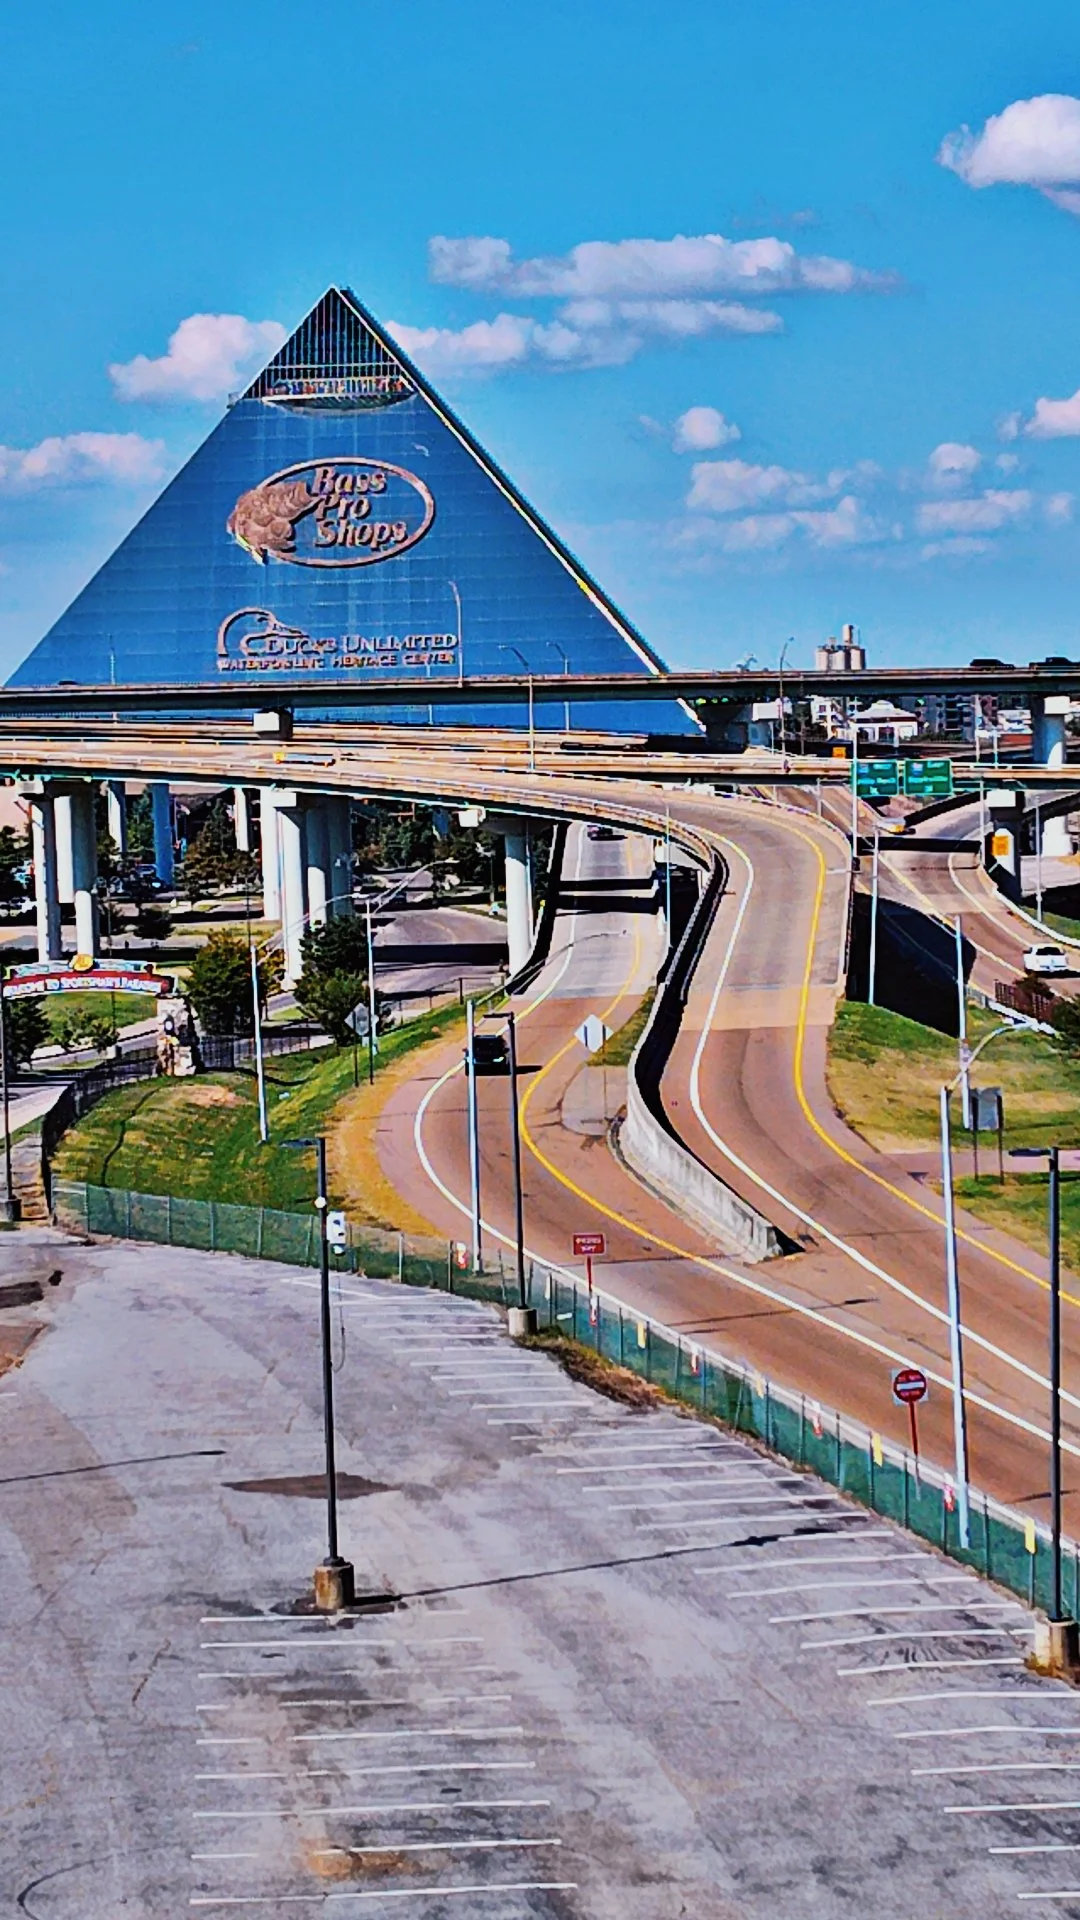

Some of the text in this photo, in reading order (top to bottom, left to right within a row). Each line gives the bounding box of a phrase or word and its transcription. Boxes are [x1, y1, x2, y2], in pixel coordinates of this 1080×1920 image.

[311, 466, 387, 494] Bass
[314, 495, 370, 520] Pro
[314, 519, 408, 550] Shops
